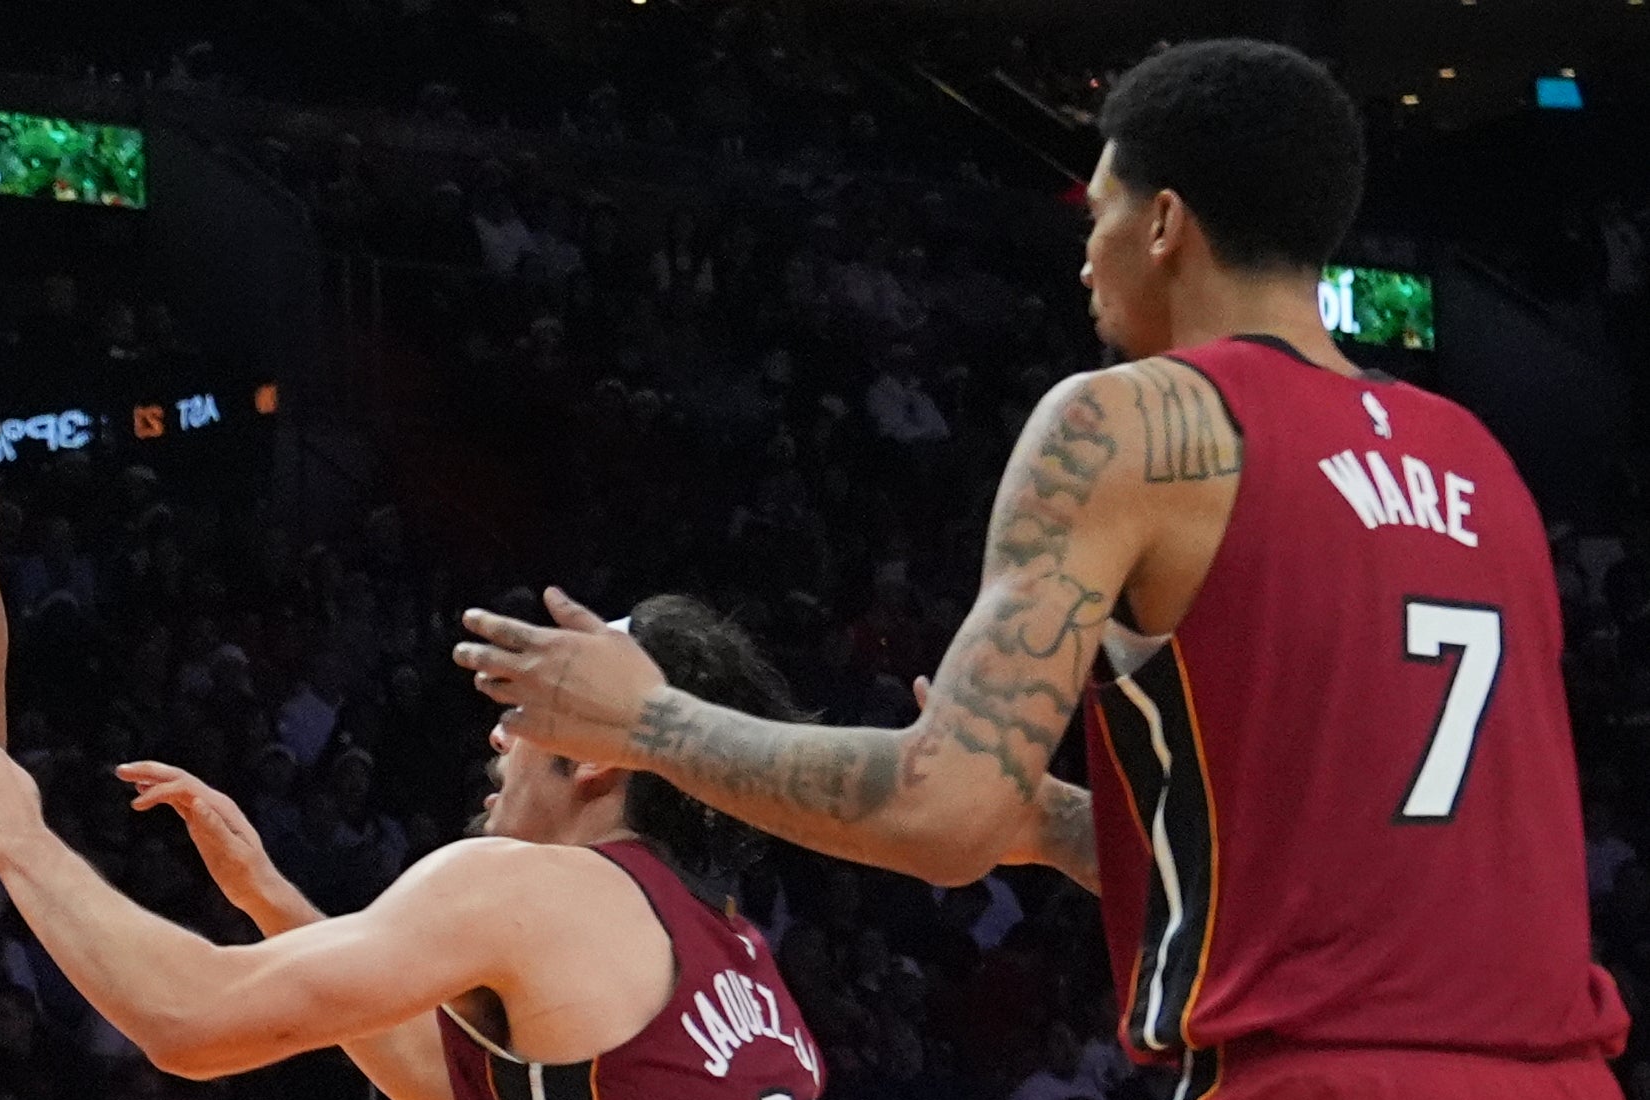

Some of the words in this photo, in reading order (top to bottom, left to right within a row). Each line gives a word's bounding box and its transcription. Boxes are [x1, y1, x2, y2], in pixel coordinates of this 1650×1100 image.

[1318, 449, 1478, 547] WARE
[1400, 600, 1502, 819] 7
[680, 969, 796, 1077] JAQUEZ
